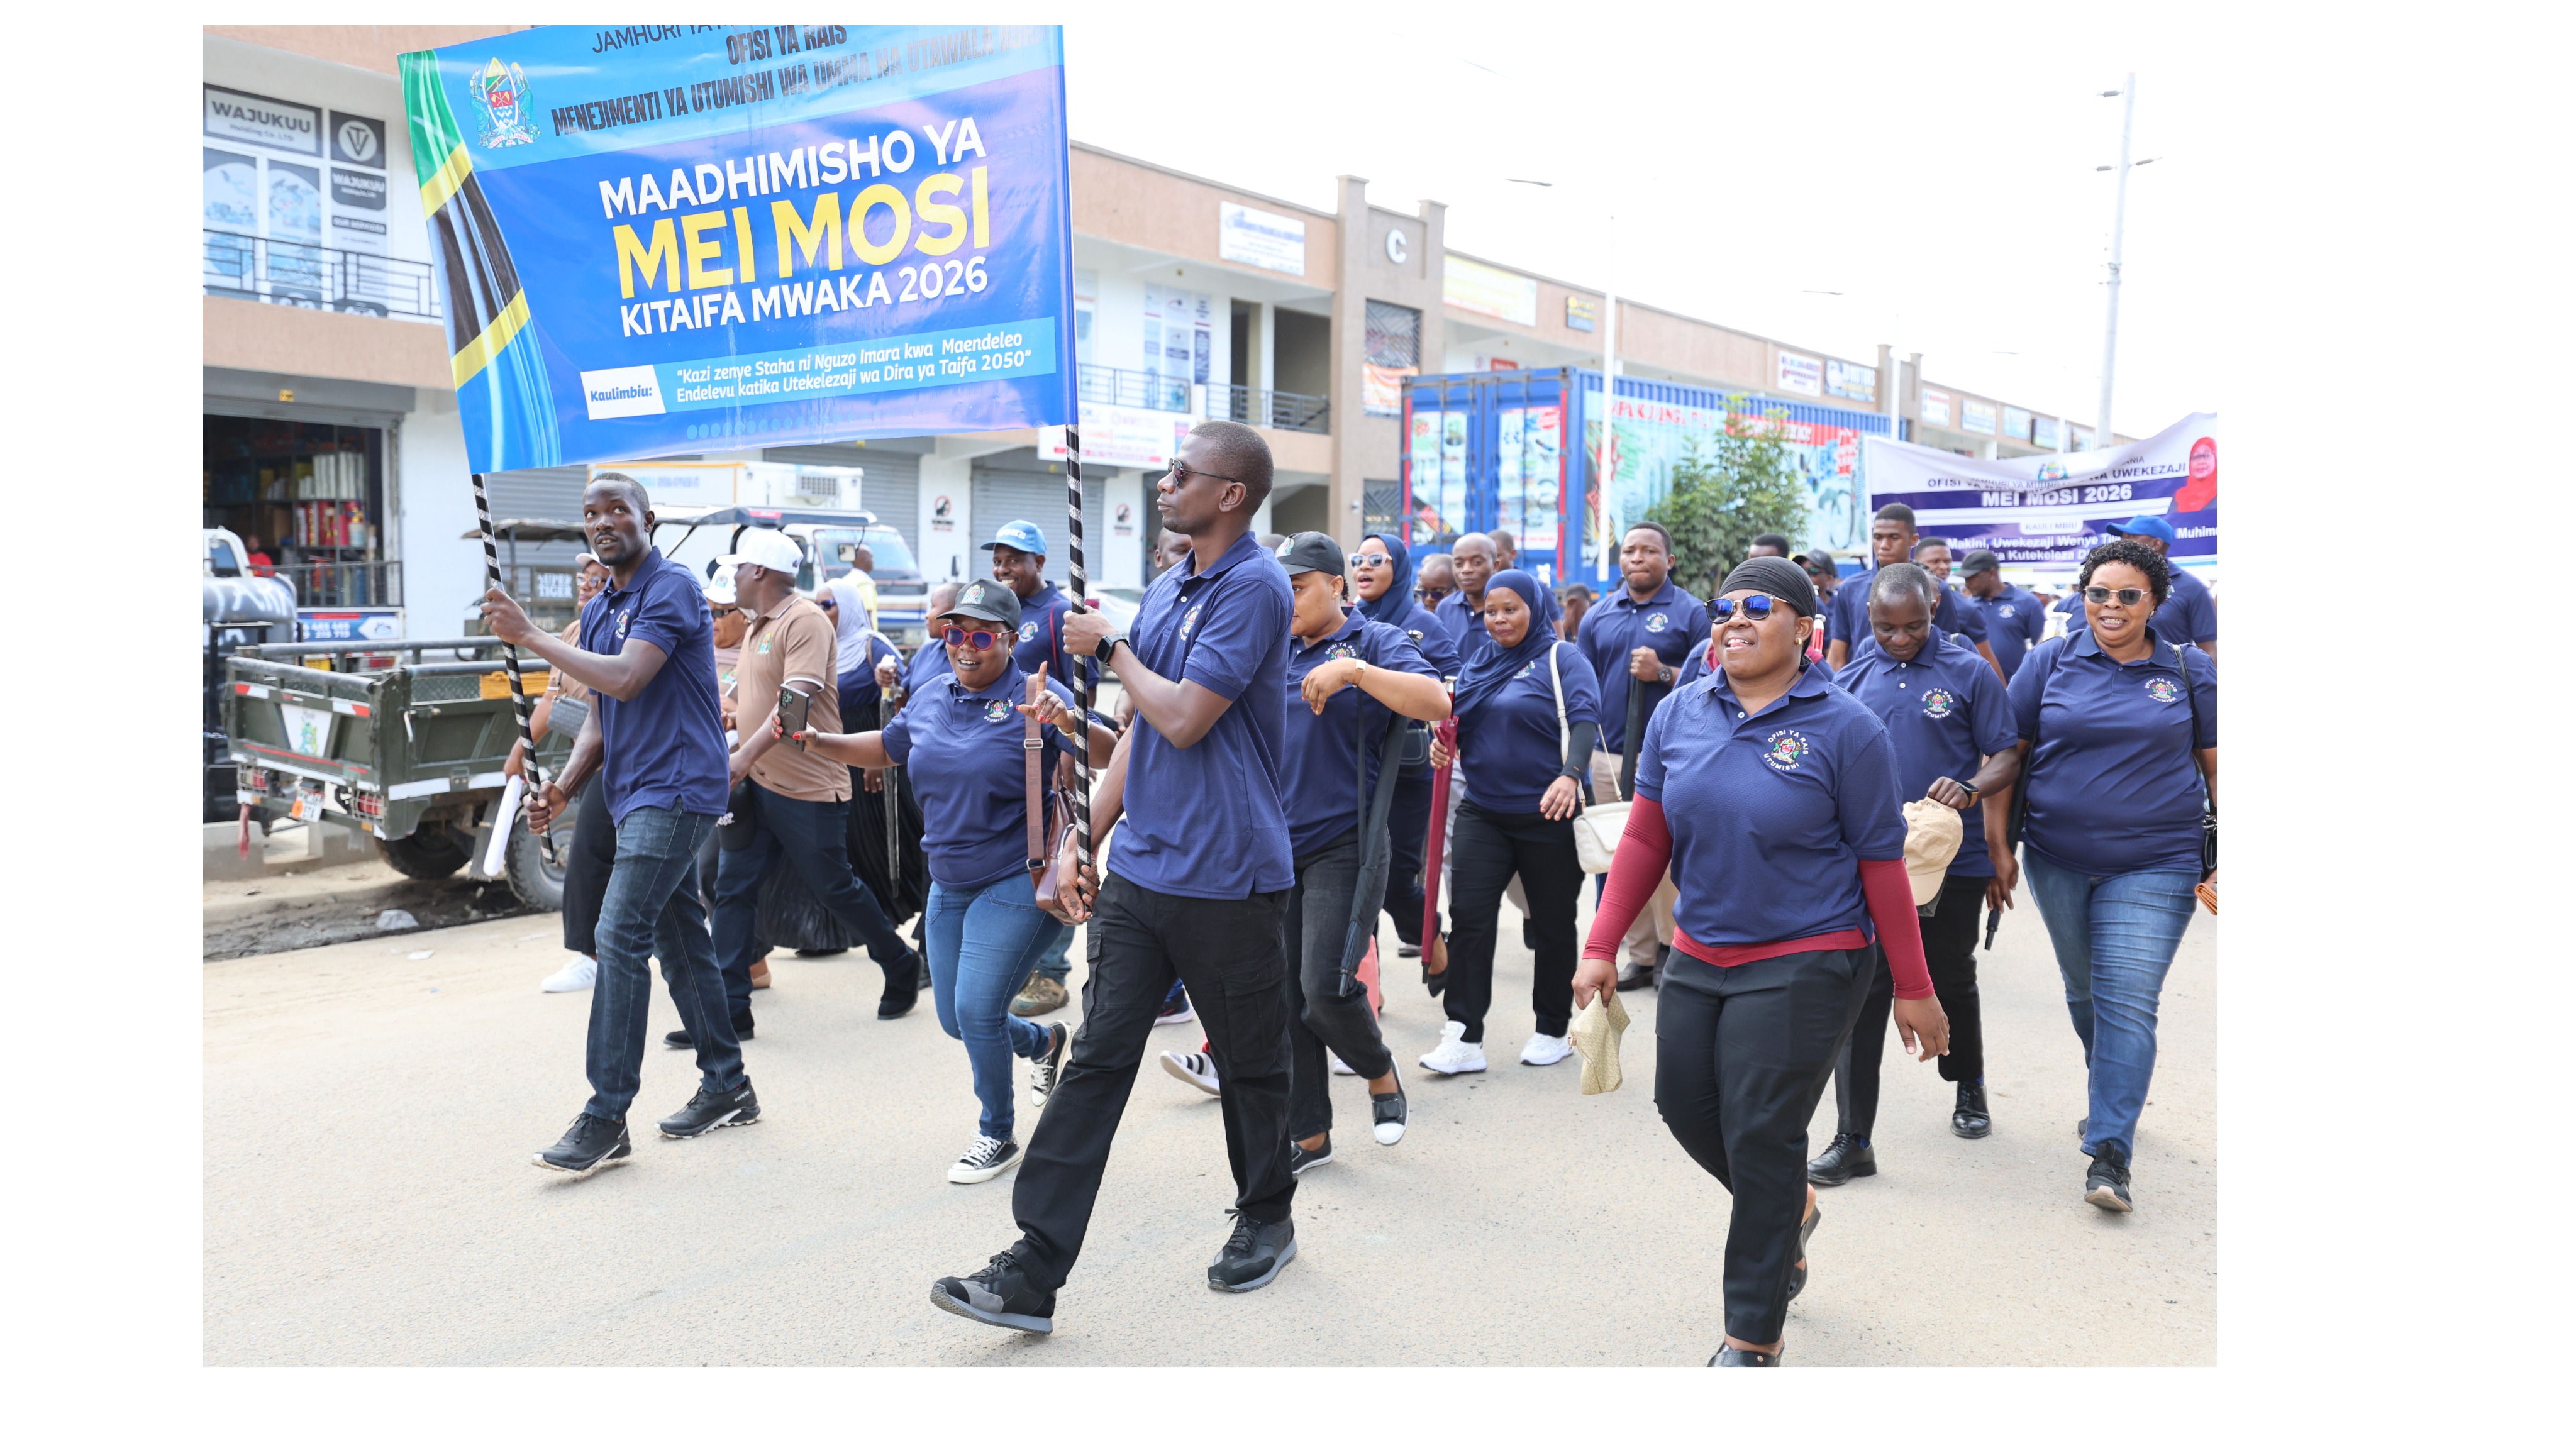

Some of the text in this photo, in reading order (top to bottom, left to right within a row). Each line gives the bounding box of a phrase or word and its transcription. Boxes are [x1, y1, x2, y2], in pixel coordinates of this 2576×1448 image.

[592, 25, 682, 53] JAMHURI
[726, 25, 848, 65] OFISI YA RAIS
[551, 92, 662, 136] MENEJIMENTI
[664, 87, 689, 118] YA
[691, 70, 775, 113] UTUMISHI
[778, 64, 811, 97] WA
[813, 52, 872, 91] UMMA
[875, 46, 903, 79] NA
[907, 27, 994, 73] UTAWALA
[211, 101, 311, 133] WAJUKUU
[599, 117, 987, 219] MAADHIMISHO YA
[613, 165, 990, 299] MEI MOSI
[1386, 229, 1407, 264] C
[620, 255, 988, 337] KITAIFA MWAKA 2026
[714, 365, 752, 386] zenye
[755, 359, 795, 377] Staha
[798, 358, 811, 372] ni
[814, 351, 856, 372] Nguzo
[860, 346, 900, 364] Imara
[904, 342, 933, 360] kwa
[941, 331, 1023, 355] Maendeleo
[590, 386, 652, 402] Kaulimbiu:
[677, 383, 735, 403] Endelevu
[738, 377, 779, 396] katika
[782, 369, 857, 392] Utekelezaji
[860, 371, 880, 384] wa
[884, 365, 914, 382] Dira
[917, 363, 935, 383] ya
[939, 358, 977, 377] Taifa
[1928, 478, 1961, 489] OFISI
[2112, 463, 2186, 478] UWEKEZAJI
[1982, 484, 2133, 507] MEI MOSI 2026
[1948, 538, 1989, 550] Makini,
[1994, 536, 2055, 550] Uwekezaji
[2058, 534, 2099, 547] Wenye
[2177, 526, 2217, 539] Muhim
[2009, 549, 2074, 560] Kutekeleza
[538, 584, 573, 598] TIGER
[1768, 729, 1809, 755] OFISI YA RAIS
[1763, 753, 1800, 770] UTUMISHI
